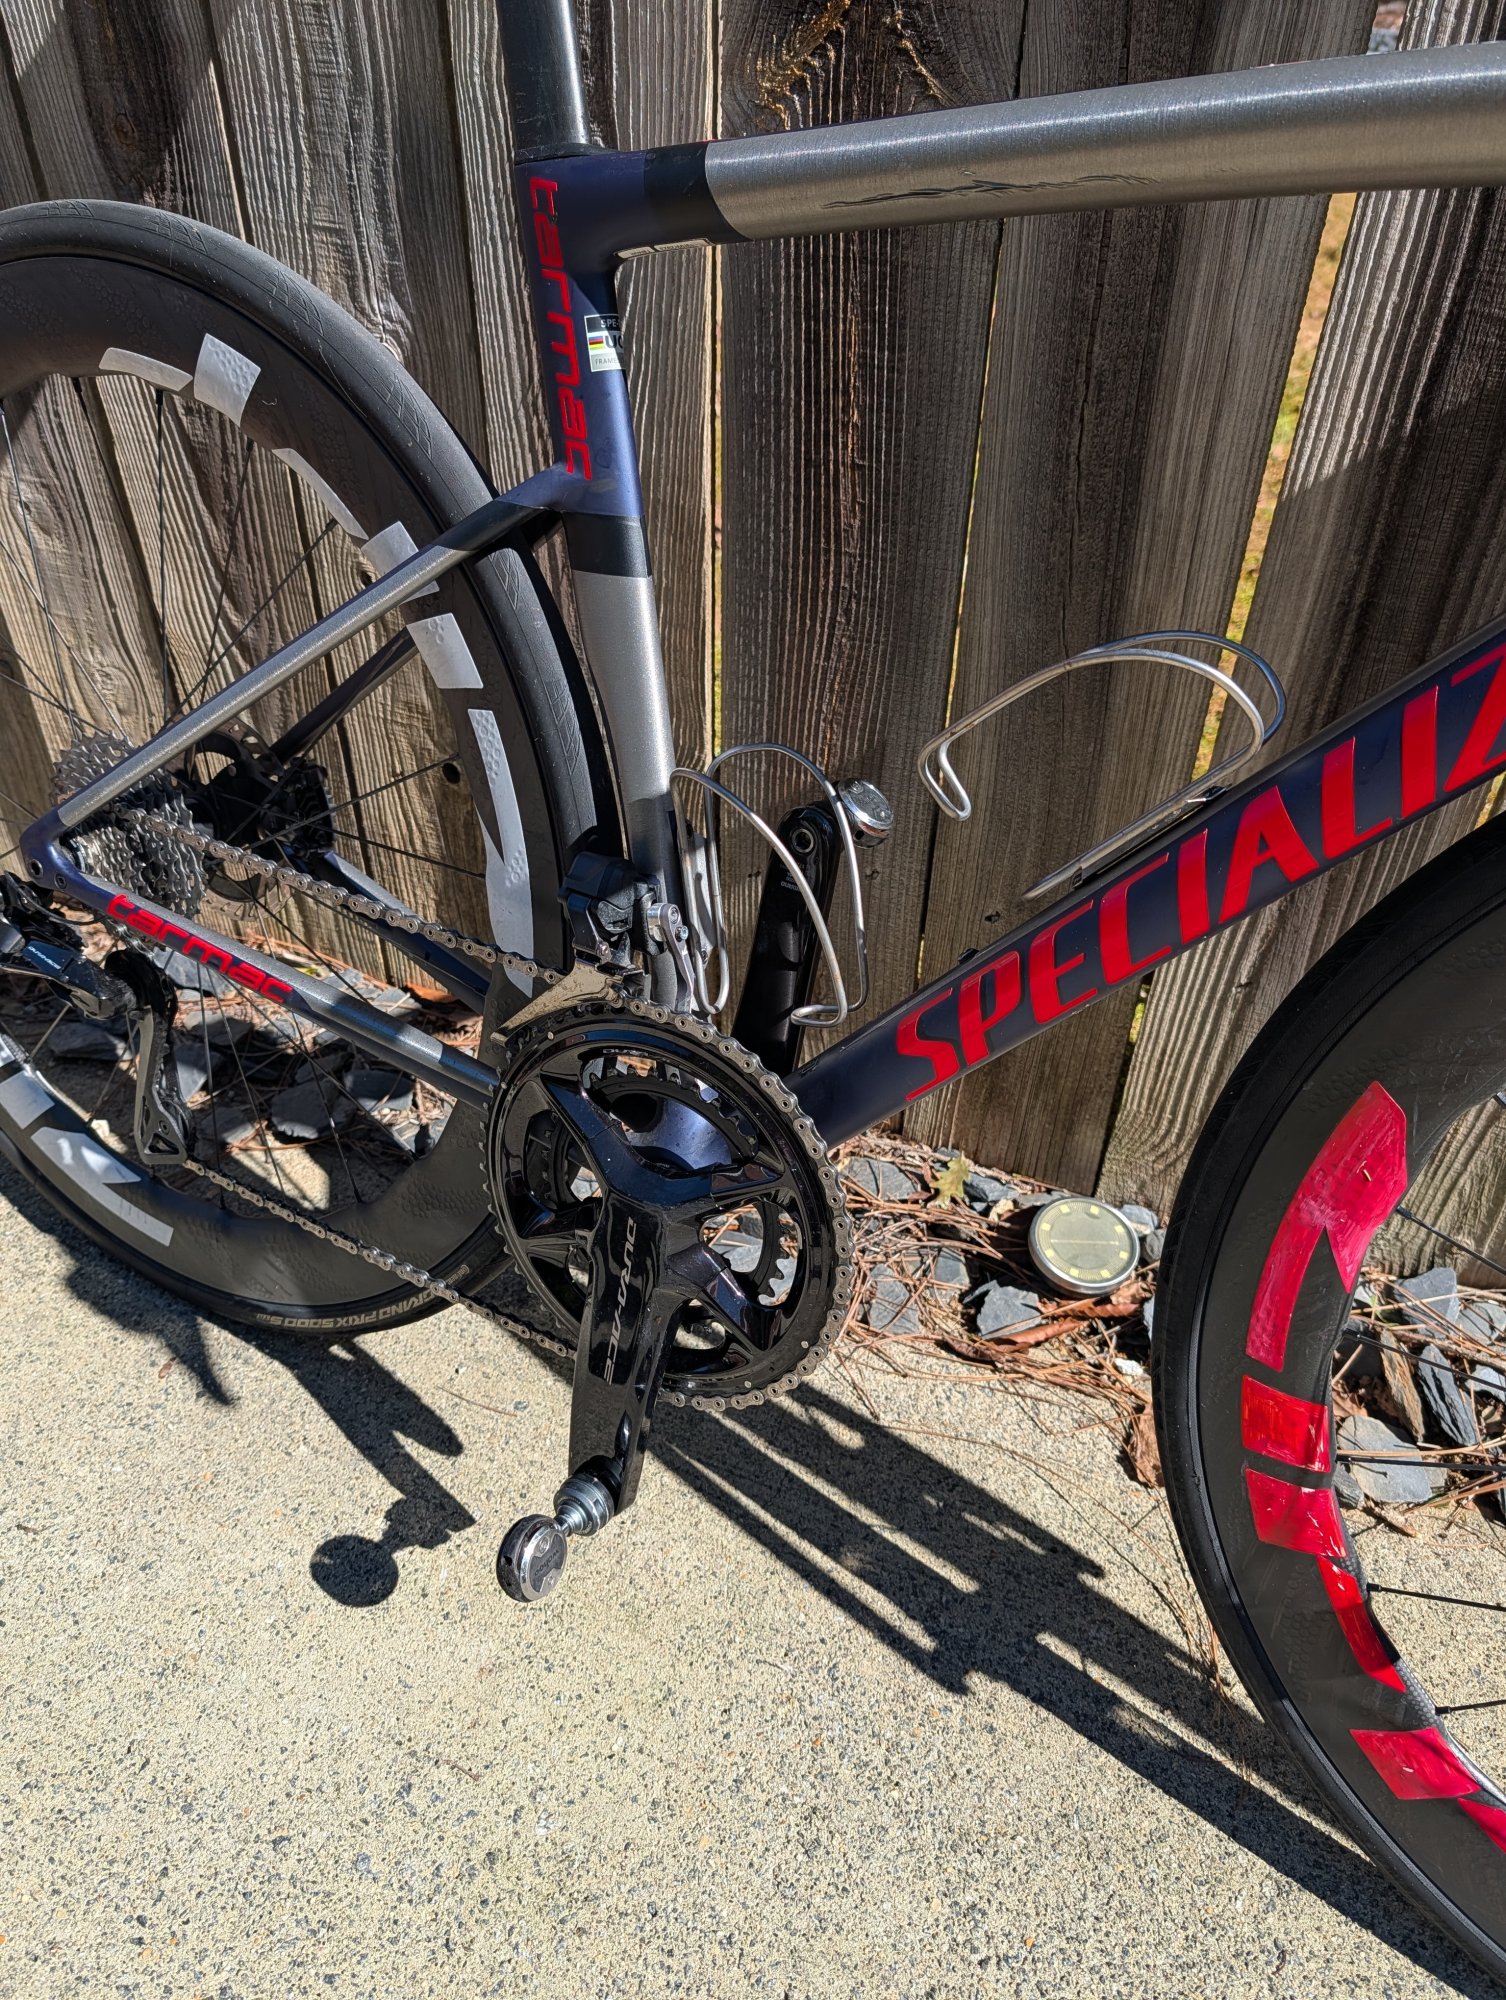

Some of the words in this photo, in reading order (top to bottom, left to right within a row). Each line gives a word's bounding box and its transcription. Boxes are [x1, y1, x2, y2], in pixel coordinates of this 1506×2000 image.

[529, 176, 592, 480] tarmac
[106, 893, 294, 1004] tarmac
[283, 1318, 335, 1328] 5000
[334, 1311, 377, 1328] PRIX
[603, 1216, 637, 1386] DURA-ACE
